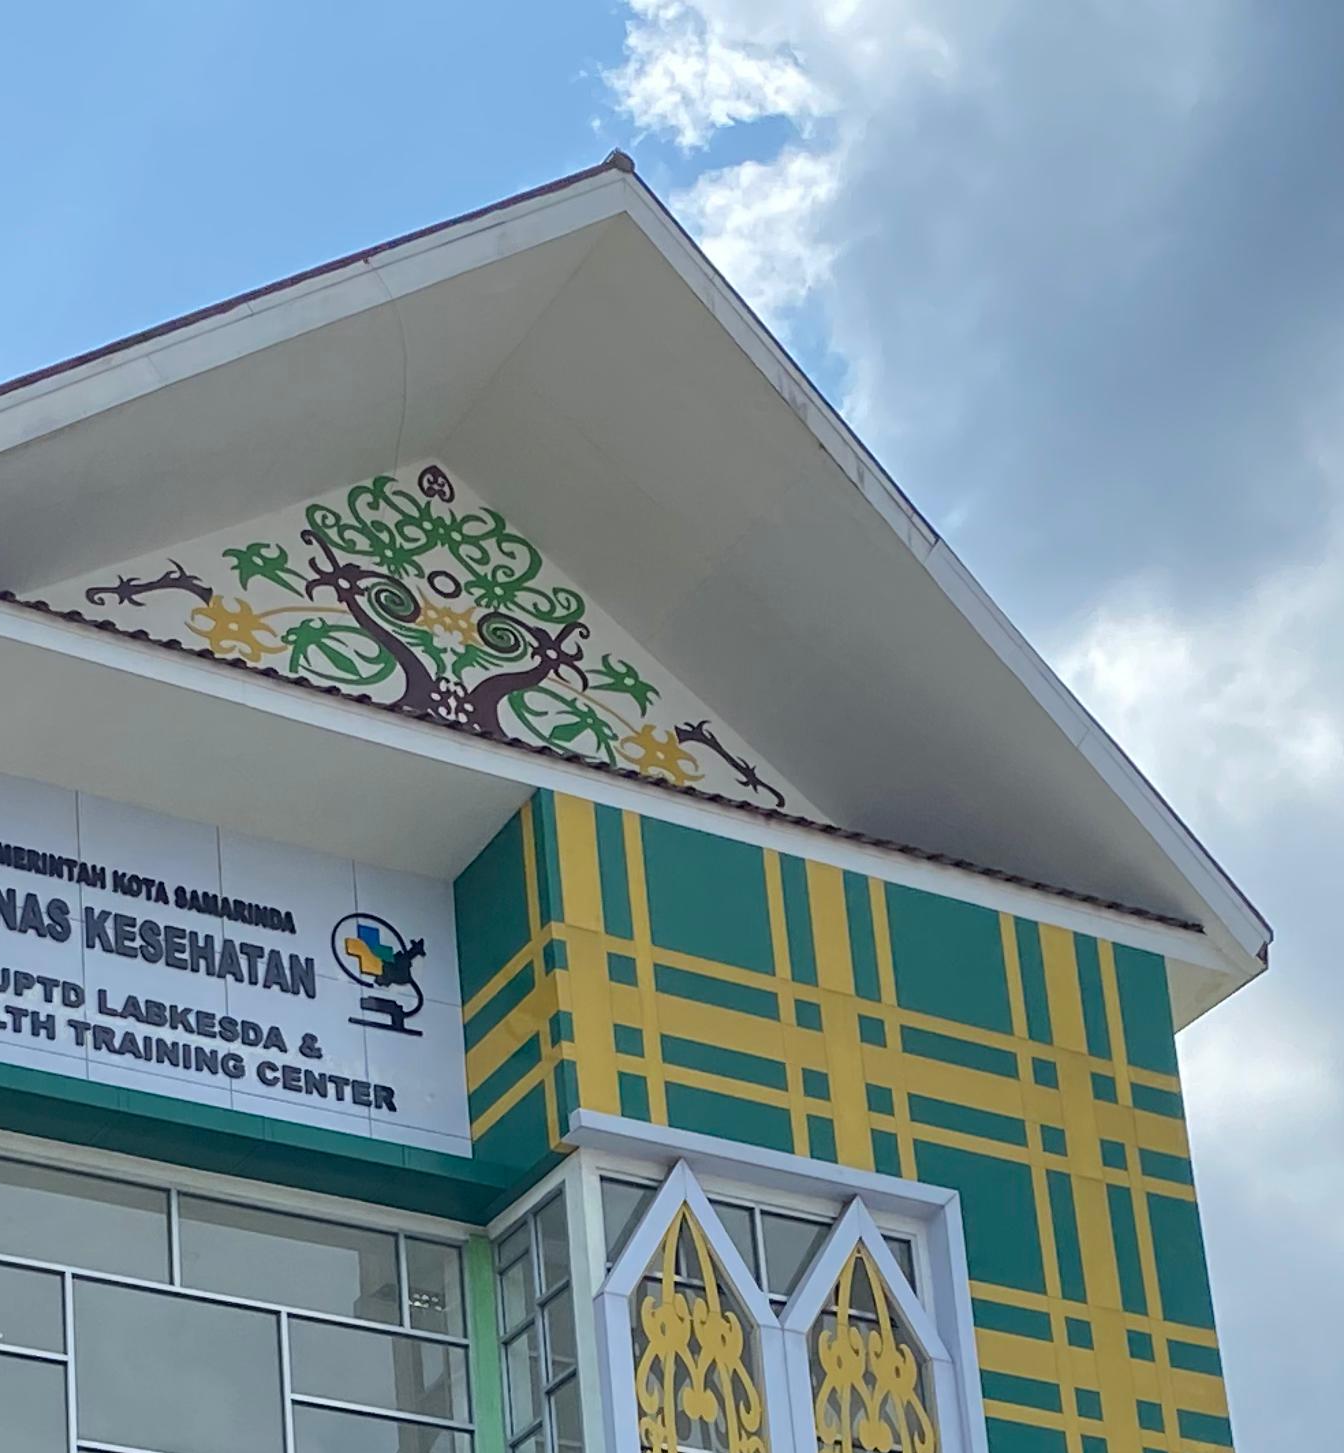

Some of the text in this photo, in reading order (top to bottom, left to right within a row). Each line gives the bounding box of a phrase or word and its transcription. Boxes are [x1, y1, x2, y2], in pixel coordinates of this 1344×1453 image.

[112, 870, 170, 905] KOTA
[174, 886, 297, 934] SAMARINDA
[84, 906, 317, 999] KESEHATAN
[97, 988, 288, 1053] LABKESDA
[299, 1033, 323, 1059] &
[67, 1018, 246, 1080] TRAINING
[257, 1060, 397, 1112] CENTER
